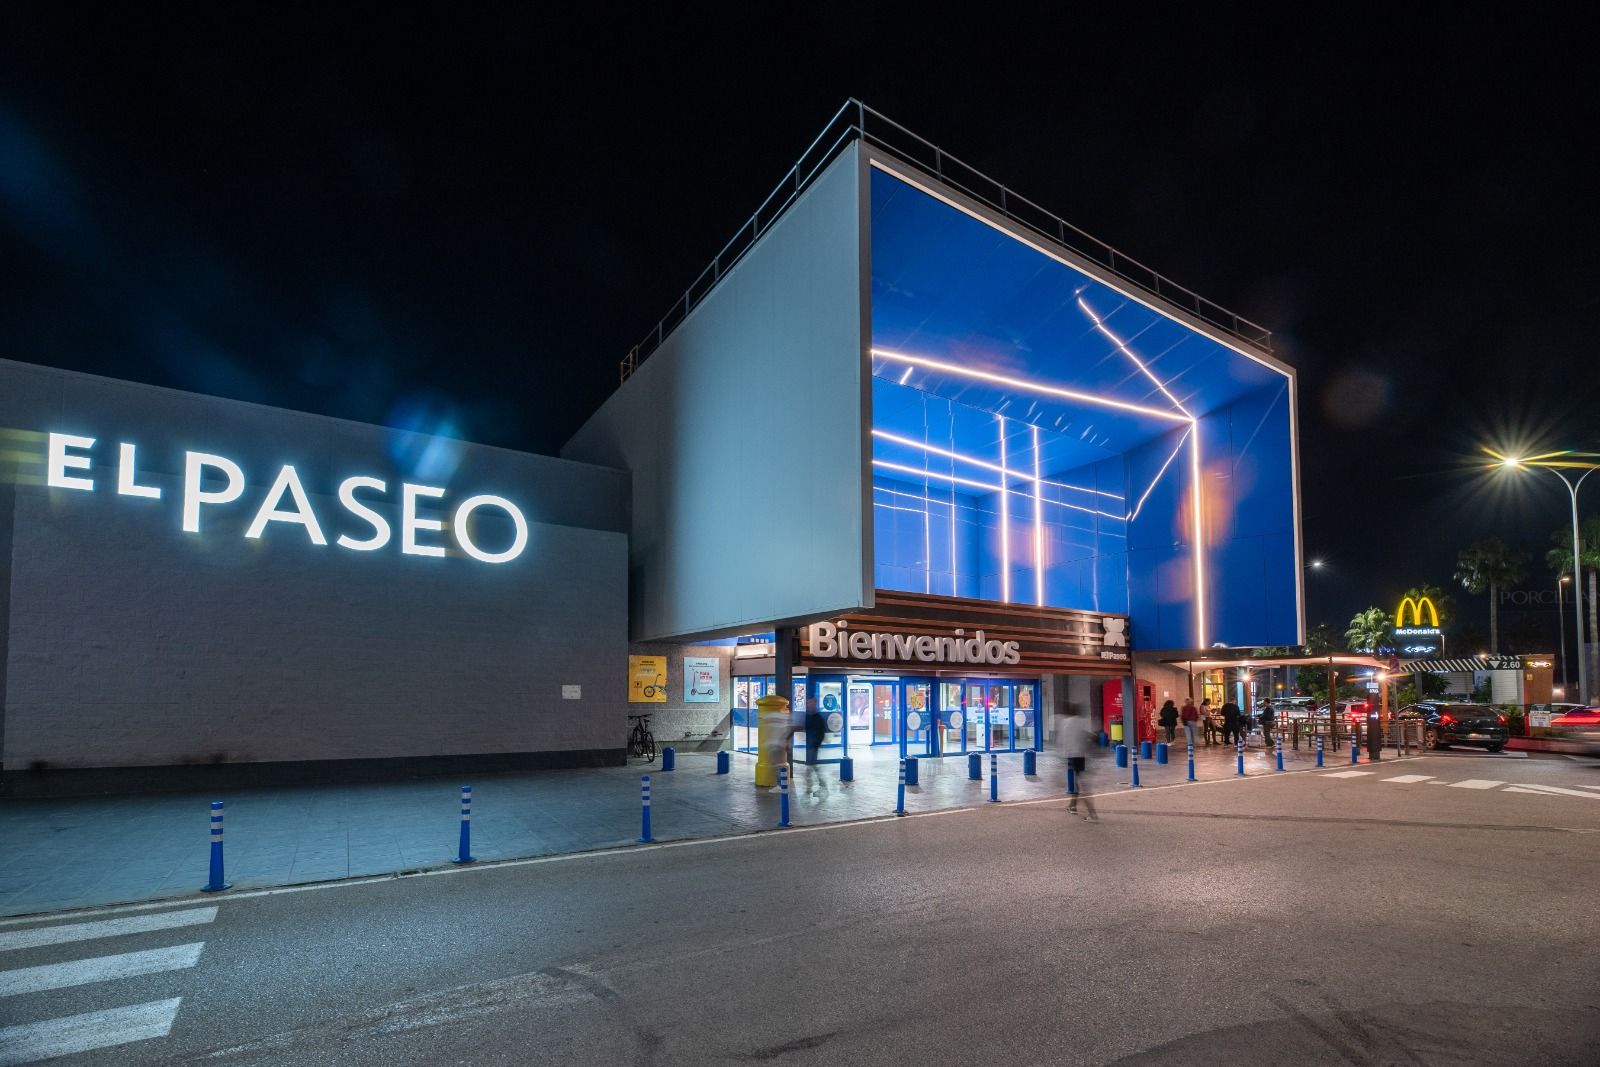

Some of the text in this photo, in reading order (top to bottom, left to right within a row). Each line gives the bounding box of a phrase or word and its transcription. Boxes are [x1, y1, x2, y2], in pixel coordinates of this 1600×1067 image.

[47, 432, 528, 563] EL PASEO
[809, 620, 1021, 664] Bienvenidos
[1502, 661, 1521, 669] 2.60
